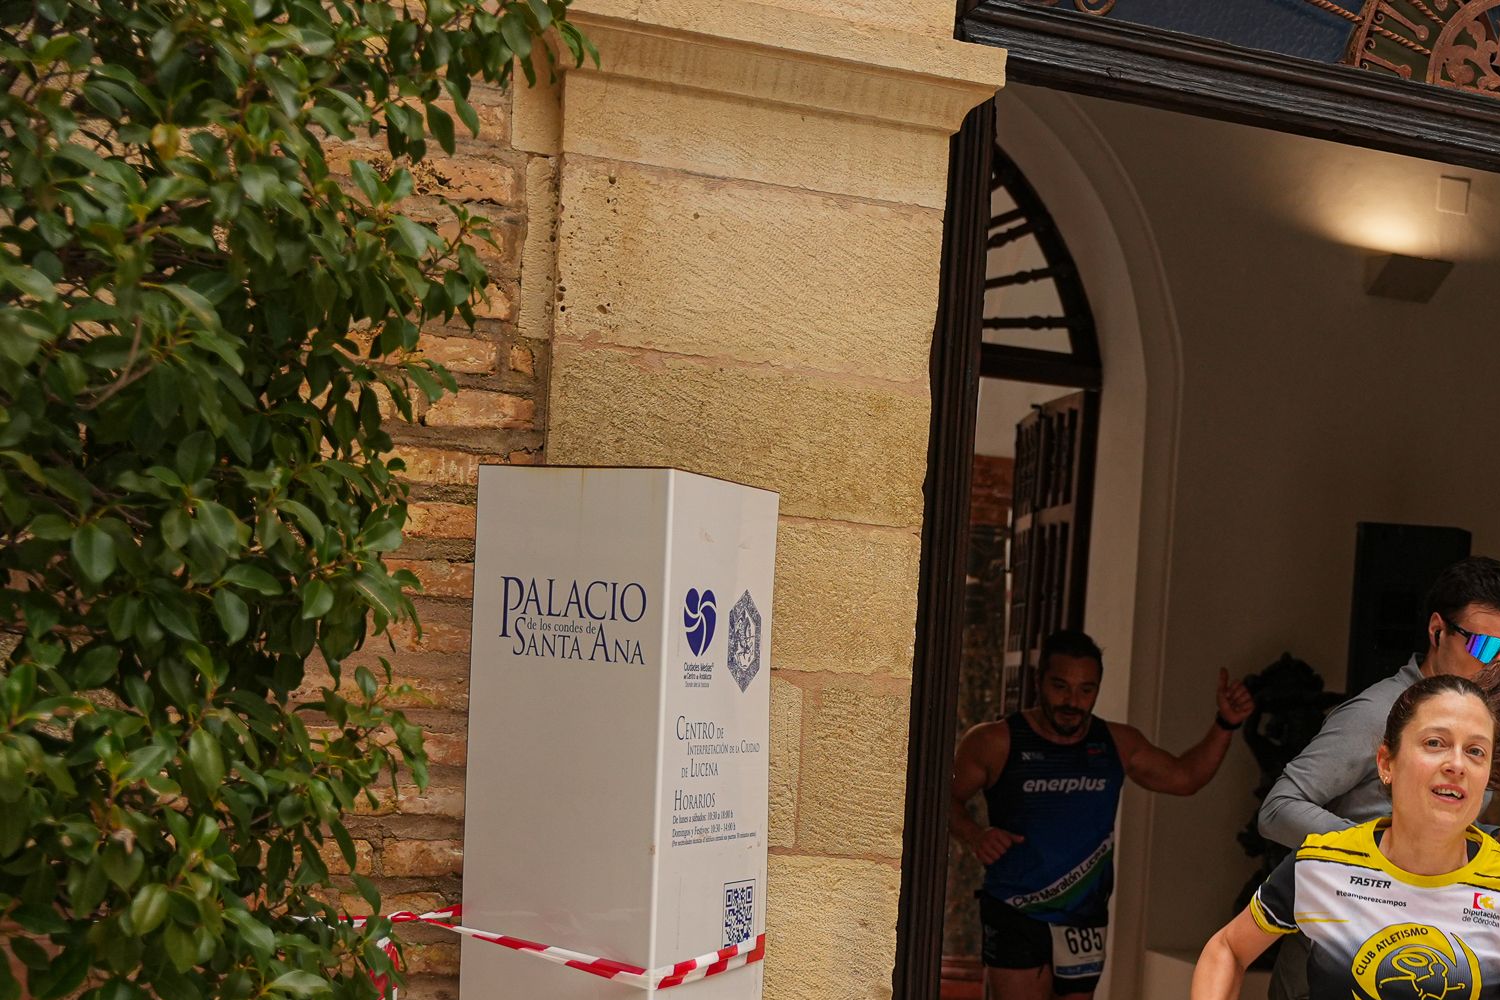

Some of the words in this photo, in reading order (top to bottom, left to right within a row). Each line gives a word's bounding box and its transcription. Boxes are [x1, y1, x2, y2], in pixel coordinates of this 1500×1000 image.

[499, 576, 647, 637] PALACIO
[526, 617, 537, 630] de
[539, 618, 552, 631] los
[553, 620, 583, 634] condes
[585, 621, 597, 635] de
[512, 616, 583, 660] SANTA
[588, 622, 646, 665] ANA
[676, 715, 715, 740] CENTRO
[716, 727, 724, 739] DE
[690, 758, 719, 778] LUCENA
[1022, 775, 1106, 794] enerplus
[674, 789, 716, 811] HORARIOS
[1038, 869, 1081, 901] Maratón
[1349, 875, 1392, 889] FASTER
[1336, 889, 1407, 907] #teamperezcampos
[1463, 907, 1500, 920] Diputación
[1064, 927, 1103, 955] 685
[1355, 950, 1376, 976] CLUB
[1375, 927, 1429, 953] ATLETISMO
